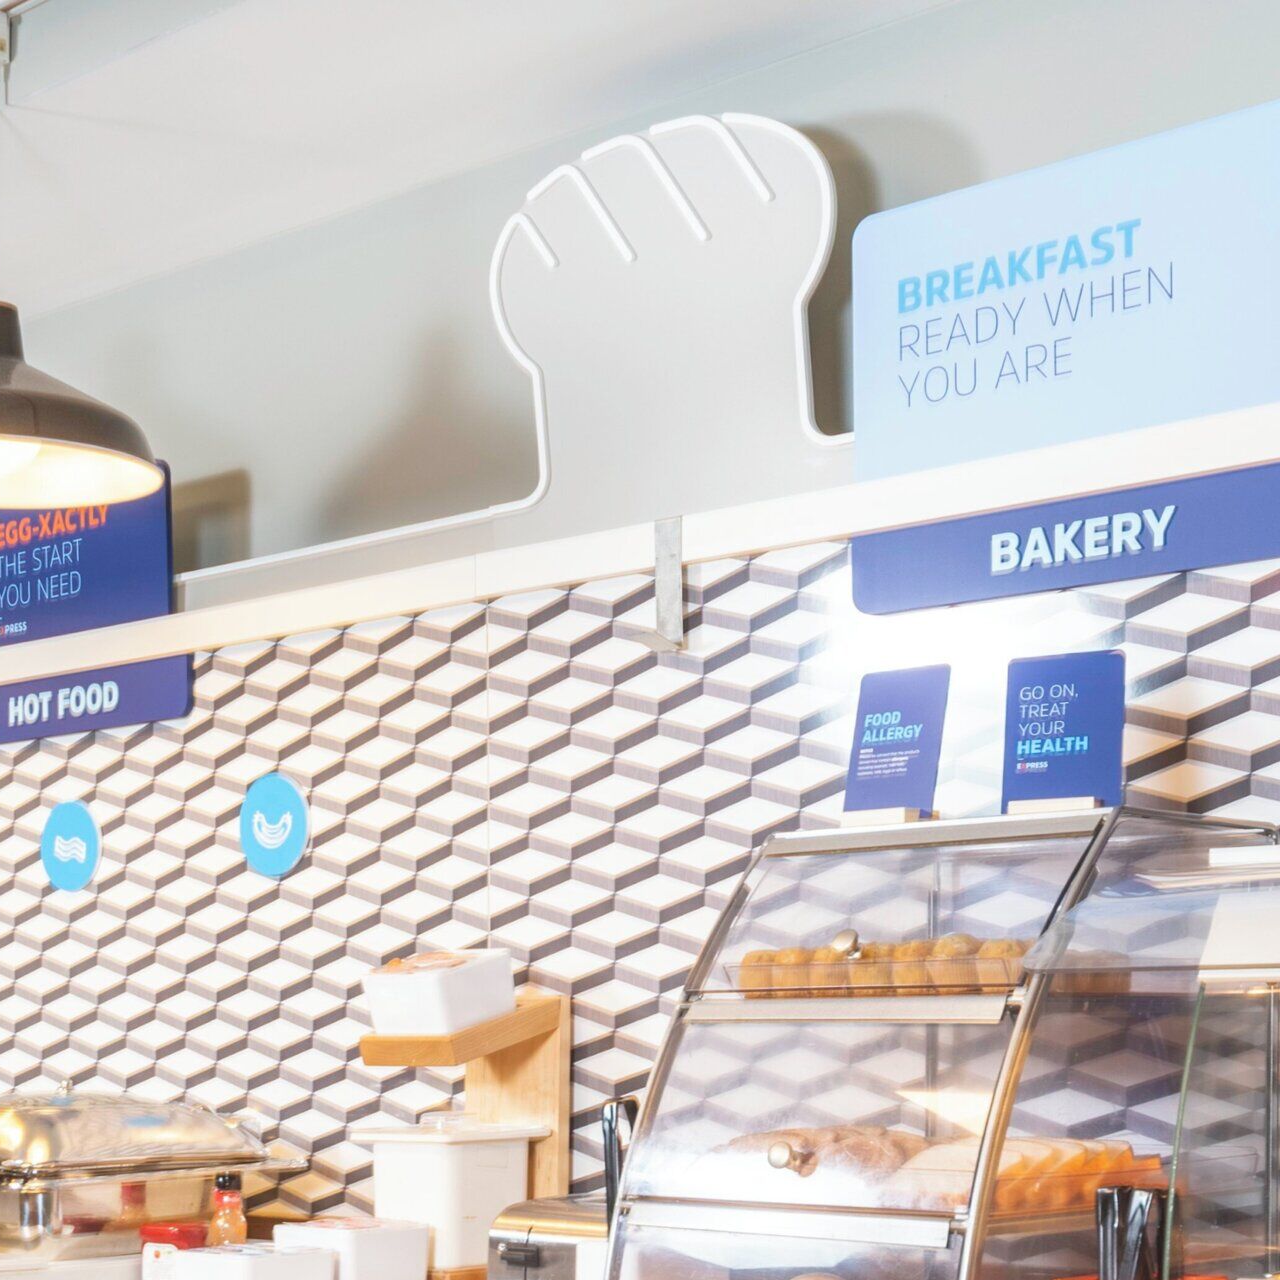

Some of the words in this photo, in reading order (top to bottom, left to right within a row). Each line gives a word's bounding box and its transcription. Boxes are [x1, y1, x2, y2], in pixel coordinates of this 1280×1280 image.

[897, 218, 1142, 315] BREAKFAST
[898, 297, 1027, 362] READY
[1043, 261, 1174, 328] WHEN
[898, 358, 978, 408] YOU
[994, 336, 1073, 390] ARE
[990, 505, 1176, 573] BAKERY
[32, 538, 83, 572] START
[37, 571, 82, 600] NEED
[8, 691, 52, 727] HOT
[57, 681, 119, 720] FOOD
[1020, 685, 1045, 702] GO
[1050, 683, 1079, 699] ON,
[864, 711, 902, 729] FOOD
[1019, 701, 1069, 719] TREAT
[861, 723, 924, 744] ALLERGY
[1019, 720, 1065, 737] YOUR
[1016, 736, 1089, 756] HEALTH
[1016, 760, 1049, 771] EXPRESS
